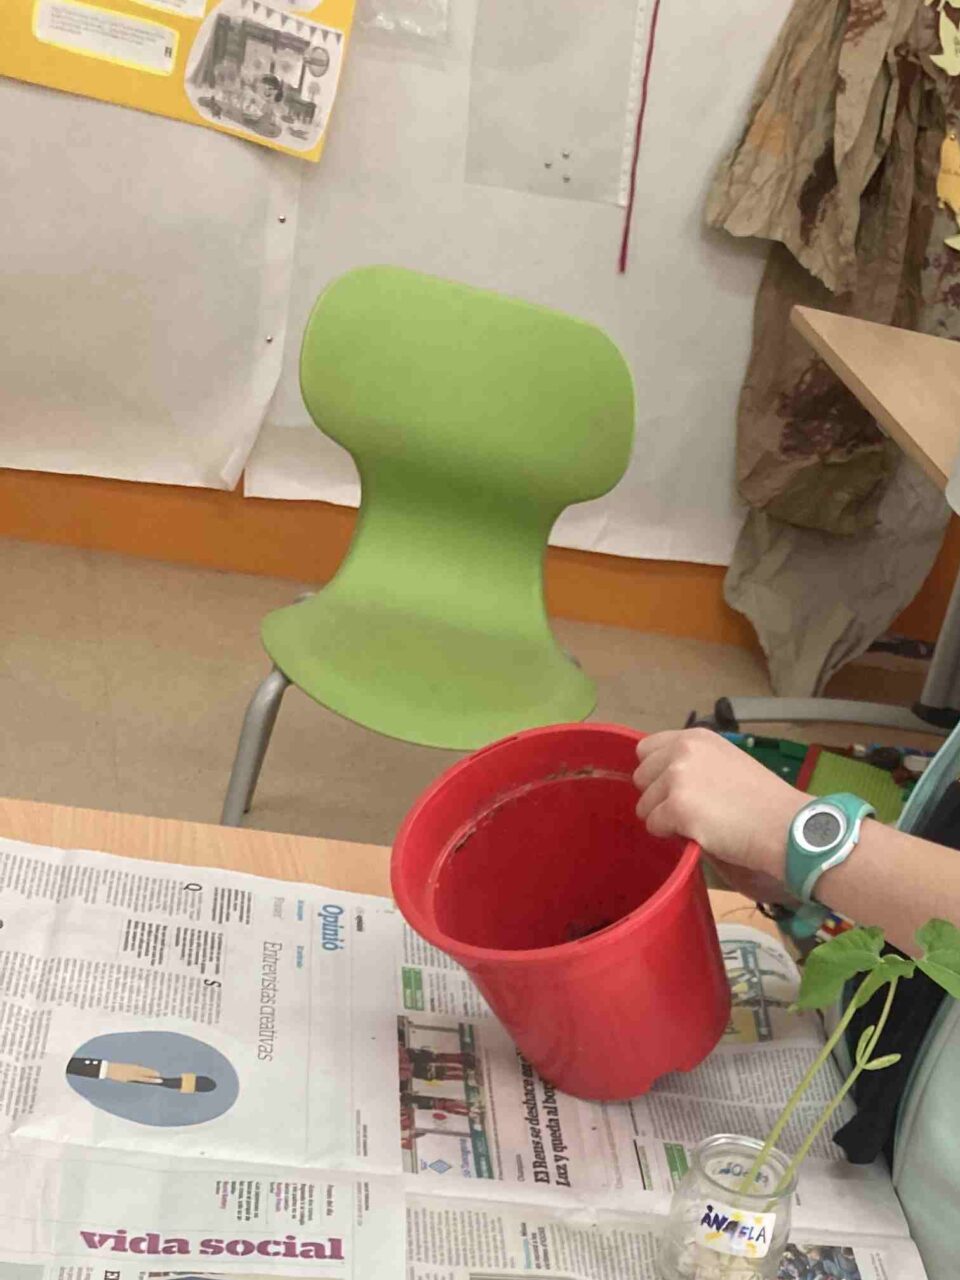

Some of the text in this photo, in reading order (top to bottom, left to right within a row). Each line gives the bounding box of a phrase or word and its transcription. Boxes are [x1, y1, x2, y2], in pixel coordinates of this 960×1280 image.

[318, 904, 344, 950] Opinió
[257, 941, 283, 1061] Entrevistas creativas
[542, 1102, 559, 1117] al
[522, 1077, 550, 1183] El Reus se deshace
[545, 1118, 567, 1152] queda
[553, 1154, 569, 1163] y
[80, 1229, 346, 1260] vida social
[103, 1270, 121, 1280] El
